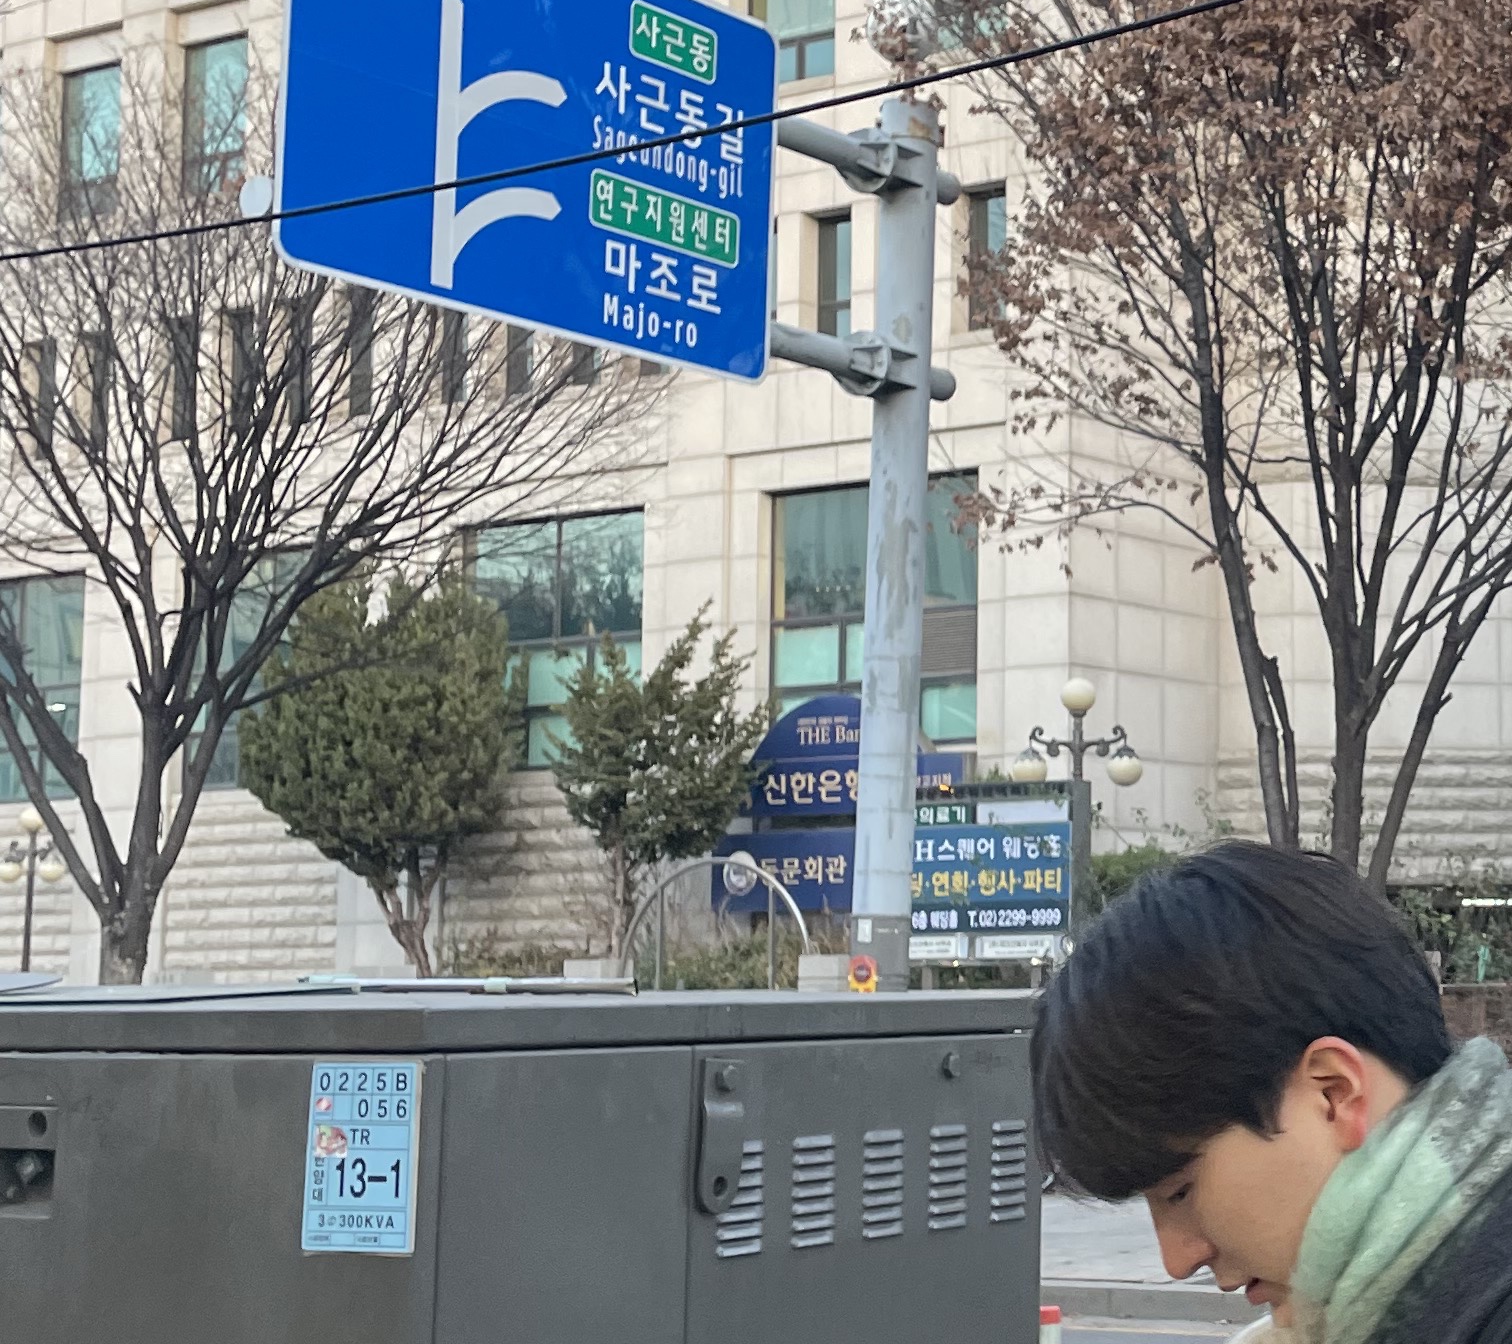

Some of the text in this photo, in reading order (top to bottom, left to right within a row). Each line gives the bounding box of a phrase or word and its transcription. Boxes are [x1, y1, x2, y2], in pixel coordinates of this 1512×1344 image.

[635, 12, 712, 73] 사근동
[595, 61, 744, 165] 사근동길
[592, 114, 743, 199] Sageundong-gil
[596, 179, 731, 254] 연구지원센터
[604, 239, 722, 315] 마조로
[603, 292, 698, 348] Majo-ro
[797, 726, 831, 745] THE
[914, 806, 966, 825] 의료기
[761, 855, 847, 886] 동문회관
[319, 1072, 408, 1092] 0225B
[358, 1099, 408, 1118] 056
[350, 1128, 370, 1146] TR
[336, 1158, 401, 1199] 13-1
